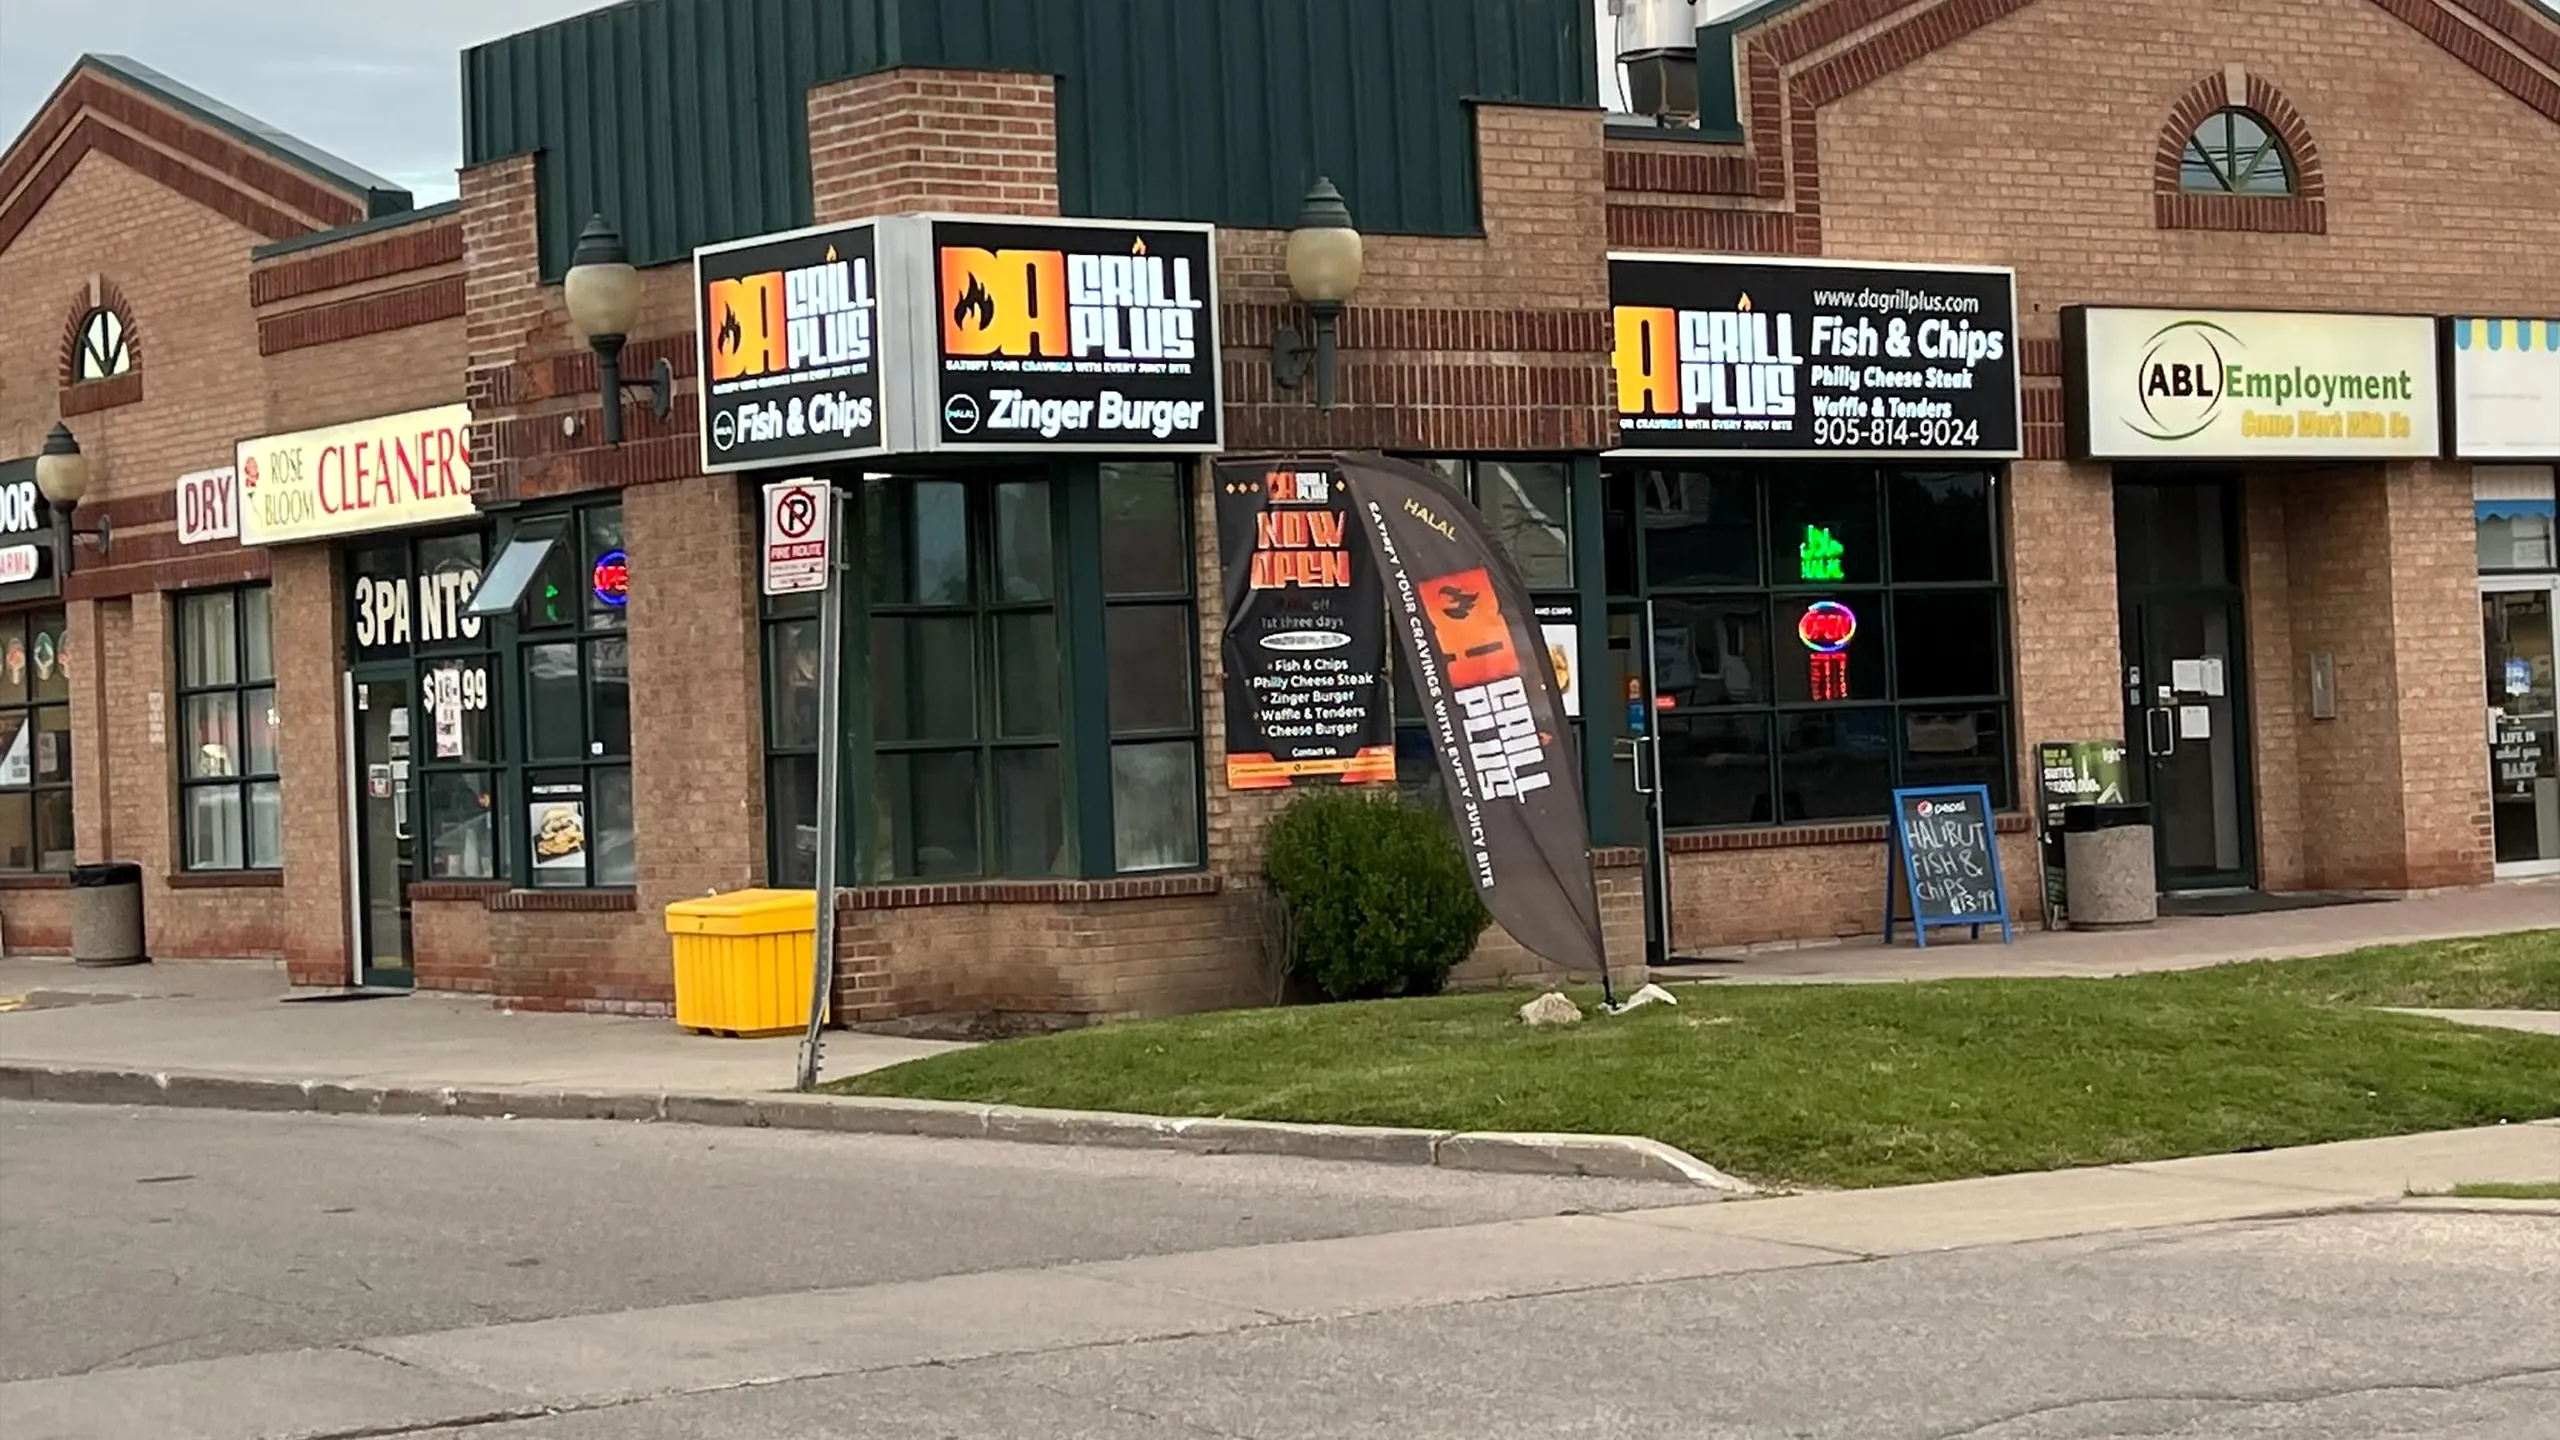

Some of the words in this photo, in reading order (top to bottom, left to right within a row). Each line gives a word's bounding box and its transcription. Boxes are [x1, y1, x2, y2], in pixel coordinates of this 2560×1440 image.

[785, 257, 875, 319] GRILL
[1067, 254, 1202, 308] GRILL
[1813, 287, 1979, 314] www.dagrillplus.com
[941, 247, 1068, 356] DA
[710, 270, 786, 381] DA
[787, 309, 870, 369] PLUS
[1069, 306, 1195, 359] PLUS
[1679, 310, 1803, 364] GRILL
[1811, 315, 1878, 356] Fish
[1885, 317, 1912, 357] &
[1918, 318, 2004, 367] Chips
[1681, 363, 1796, 415] PLUS
[1811, 365, 1860, 391] Philly
[1863, 366, 1922, 388] Cheese
[1925, 367, 1973, 388] Steak
[2148, 363, 2213, 397] ABL
[2226, 365, 2412, 407] Employment
[737, 401, 783, 443] Fish
[786, 398, 806, 436] &
[808, 391, 873, 438] Chips
[987, 389, 1094, 438] Zinger
[1098, 391, 1204, 438] Burger
[1812, 396, 1868, 418] Waffle
[1871, 396, 1885, 418] &
[1888, 397, 1952, 418] Tenders
[2241, 410, 2295, 438] Come
[2297, 410, 2343, 438] Work
[2346, 411, 2386, 438] With
[1813, 417, 1980, 446] 905-814-9024
[271, 447, 303, 485] ROSE
[317, 423, 472, 514] CLEANERS
[185, 475, 233, 534] DRY
[265, 488, 315, 526] BLOOM
[1403, 498, 1457, 542] HALAL
[1257, 510, 1346, 549] NOW
[1251, 551, 1350, 589] OPEN
[1261, 616, 1278, 628] 1st
[1281, 616, 1313, 628] three
[1316, 615, 1344, 630] days
[1804, 612, 1851, 640] OPEN
[1253, 675, 1288, 690] Philly
[1290, 675, 1335, 687] Cheese
[1337, 672, 1374, 686] Steak
[1275, 659, 1301, 672] Fish
[1303, 660, 1312, 671] &
[1314, 658, 1349, 672] Chips
[1261, 707, 1301, 721] Waffle
[1303, 708, 1313, 720] &
[1315, 706, 1366, 720] Tenders
[1270, 692, 1310, 706] Zinger
[1312, 690, 1355, 704] Burger
[1267, 725, 1313, 738] Cheese
[1315, 722, 1358, 737] Burger
[1395, 569, 1417, 614] YOUR
[1410, 616, 1442, 698] CRAVINGS
[1434, 700, 1455, 744] WITH
[1447, 747, 1473, 798] EVERY
[1465, 801, 1486, 848] JUICY
[1476, 851, 1495, 888] BITE
[1454, 686, 1517, 801] PLUS
[1486, 676, 1551, 804] GRILL
[1911, 851, 1958, 879] FISH
[1960, 849, 1984, 877] &
